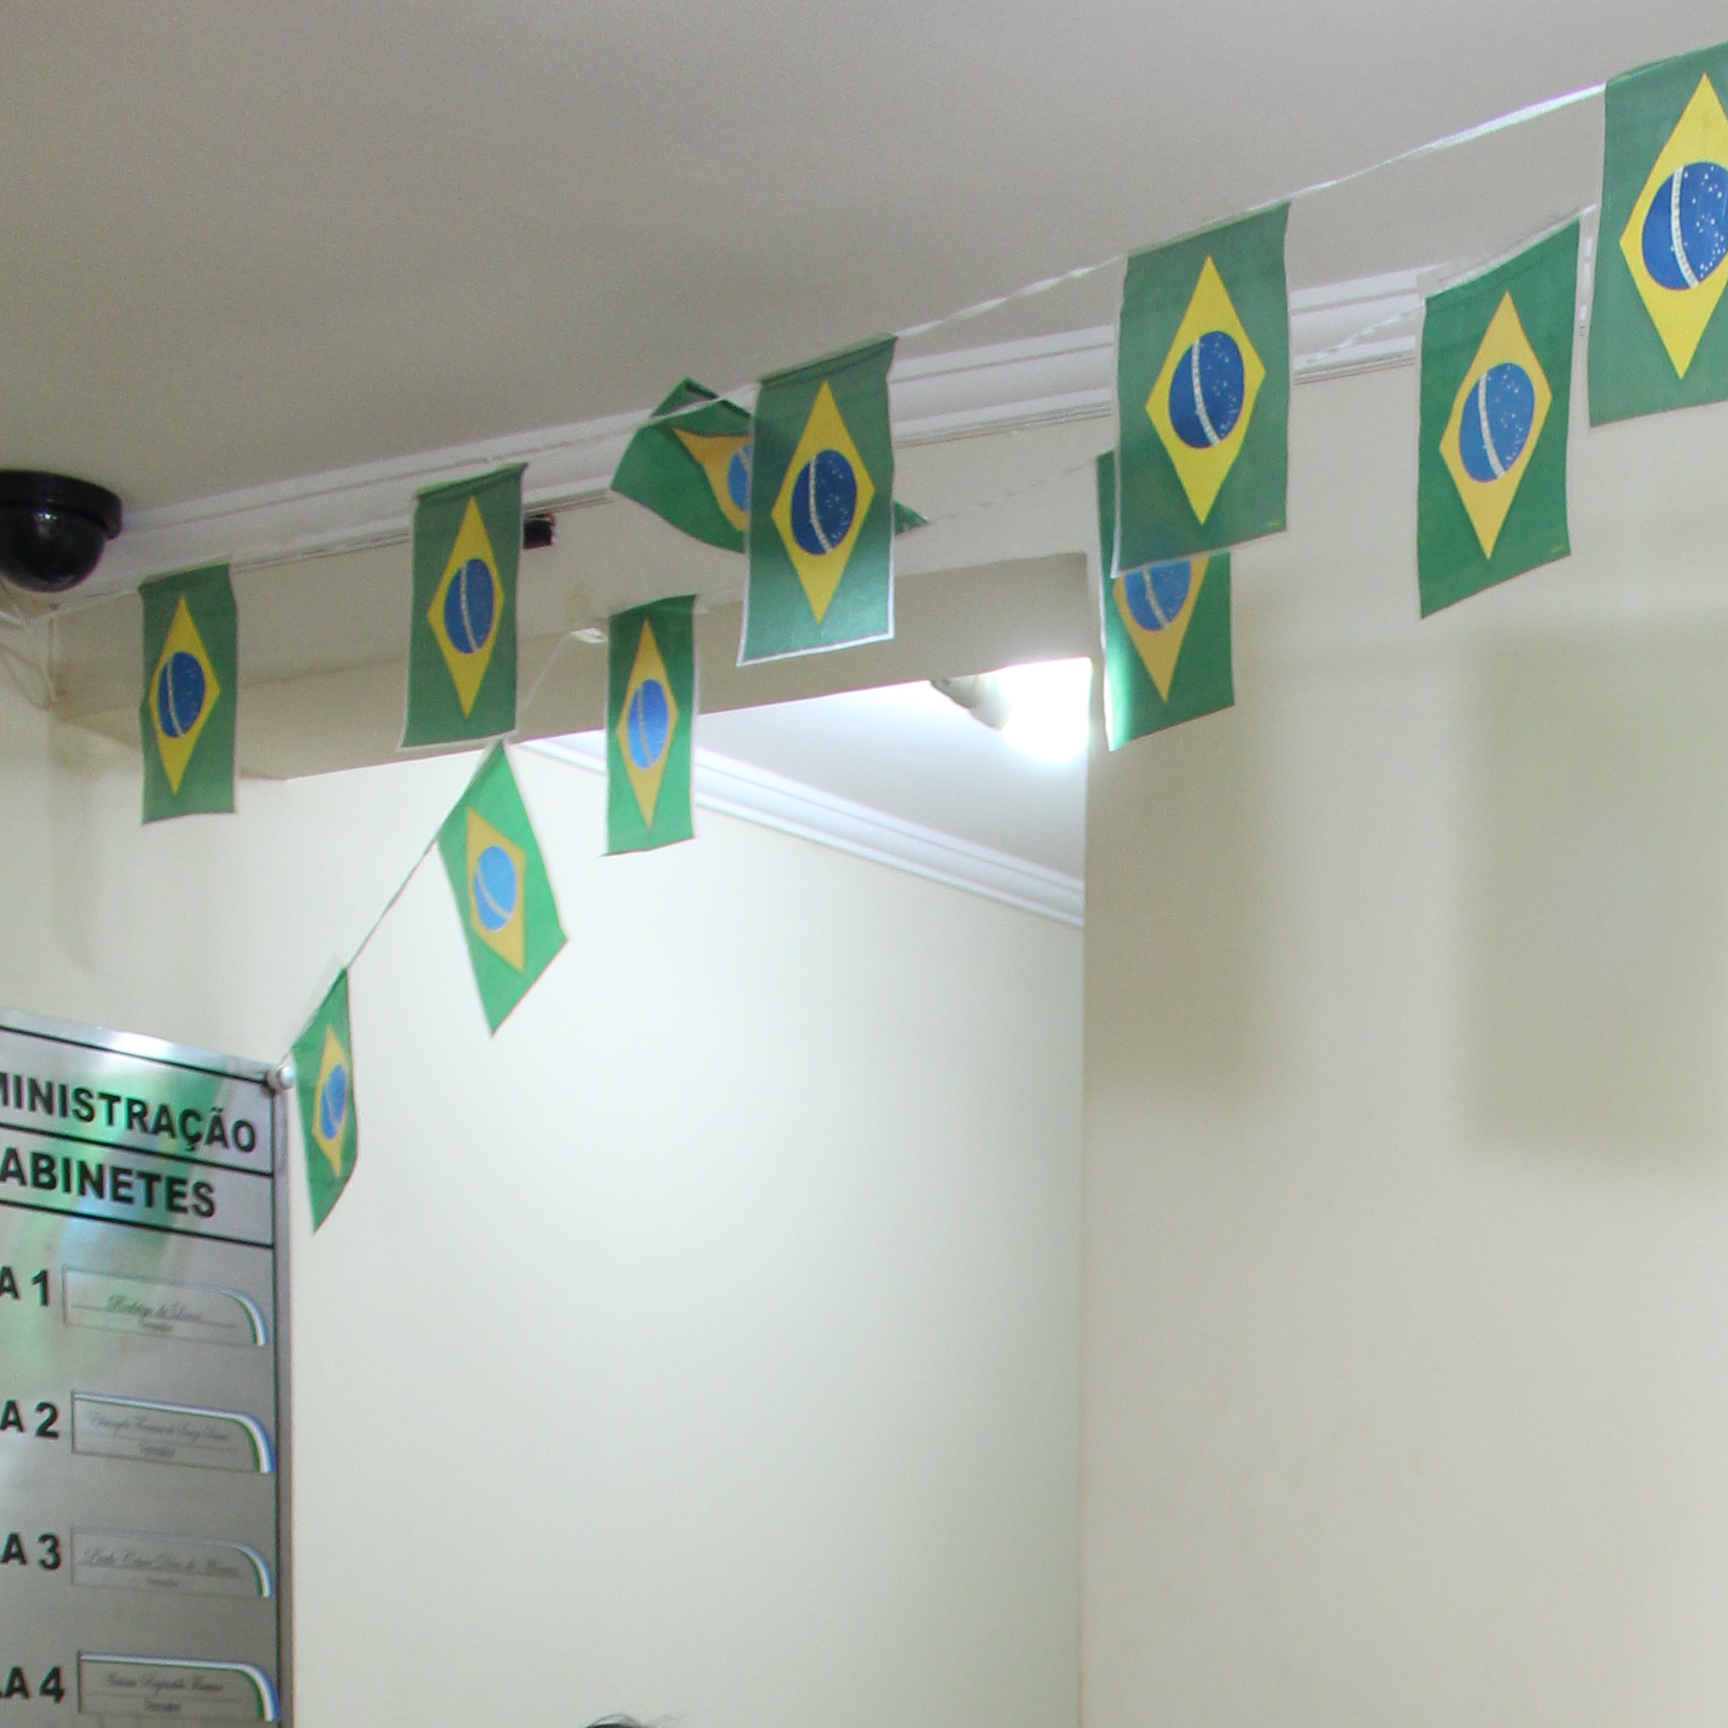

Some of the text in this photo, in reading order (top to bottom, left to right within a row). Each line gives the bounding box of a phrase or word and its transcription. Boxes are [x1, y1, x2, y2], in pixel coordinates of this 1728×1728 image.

[31, 1269, 49, 1306] 1
[34, 1401, 60, 1439] 2
[37, 1533, 62, 1571] 3
[0, 1666, 30, 1700] A
[39, 1666, 65, 1704] 4
